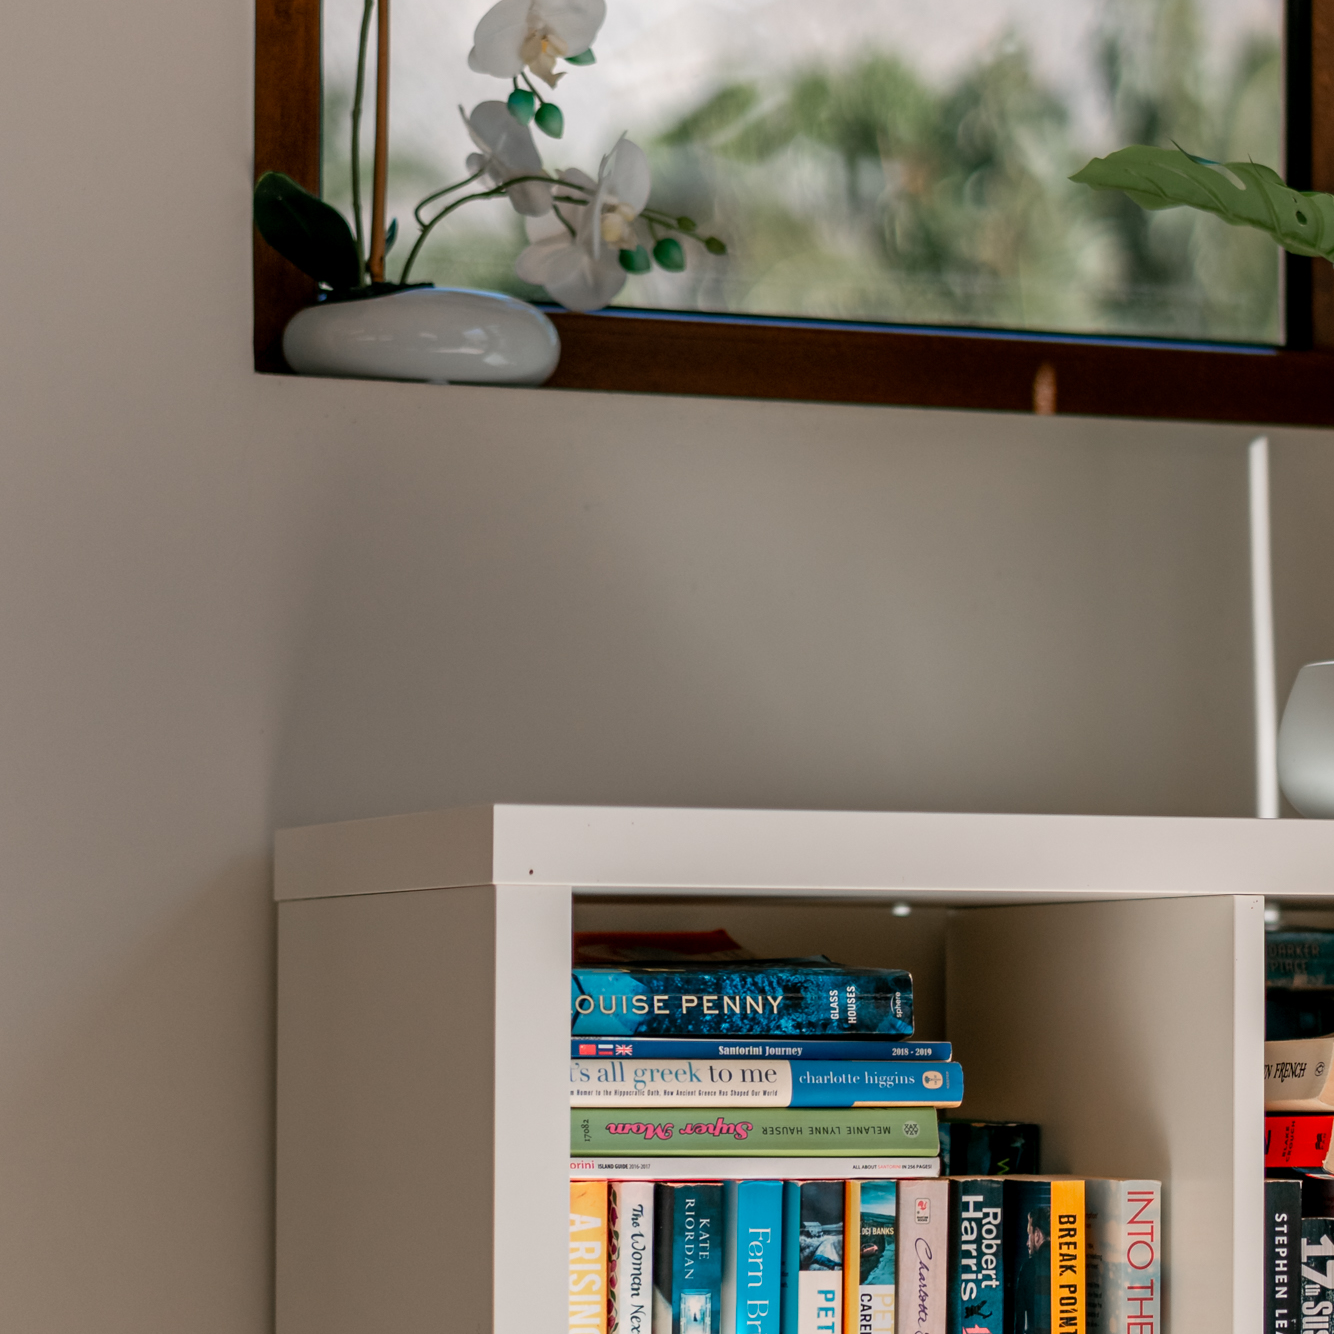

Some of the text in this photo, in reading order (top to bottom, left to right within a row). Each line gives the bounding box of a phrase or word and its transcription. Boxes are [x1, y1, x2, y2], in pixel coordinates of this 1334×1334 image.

[571, 994, 784, 1015] OUISE PENNY
[830, 989, 840, 1021] GLASS
[848, 986, 857, 1024] HOUSES
[718, 1044, 802, 1057] Santorini Journey
[892, 1047, 933, 1056] 2018 2019
[597, 1059, 778, 1090] all greek to me
[799, 1072, 915, 1088] charlotte higgins
[1274, 1062, 1307, 1082] FRENCH
[762, 1125, 892, 1135] MELANIE LYNNE HAUSER
[632, 1204, 644, 1228] The
[1126, 1190, 1154, 1271] INTO
[684, 1198, 695, 1280] RIORDAN
[699, 1218, 710, 1260] KATE
[747, 1227, 772, 1288] Fern
[961, 1196, 984, 1301] Harris
[981, 1207, 1001, 1289] Robert
[1058, 1214, 1077, 1276] BREAK
[1274, 1213, 1288, 1299] STEPHEN
[630, 1232, 646, 1298] Woman
